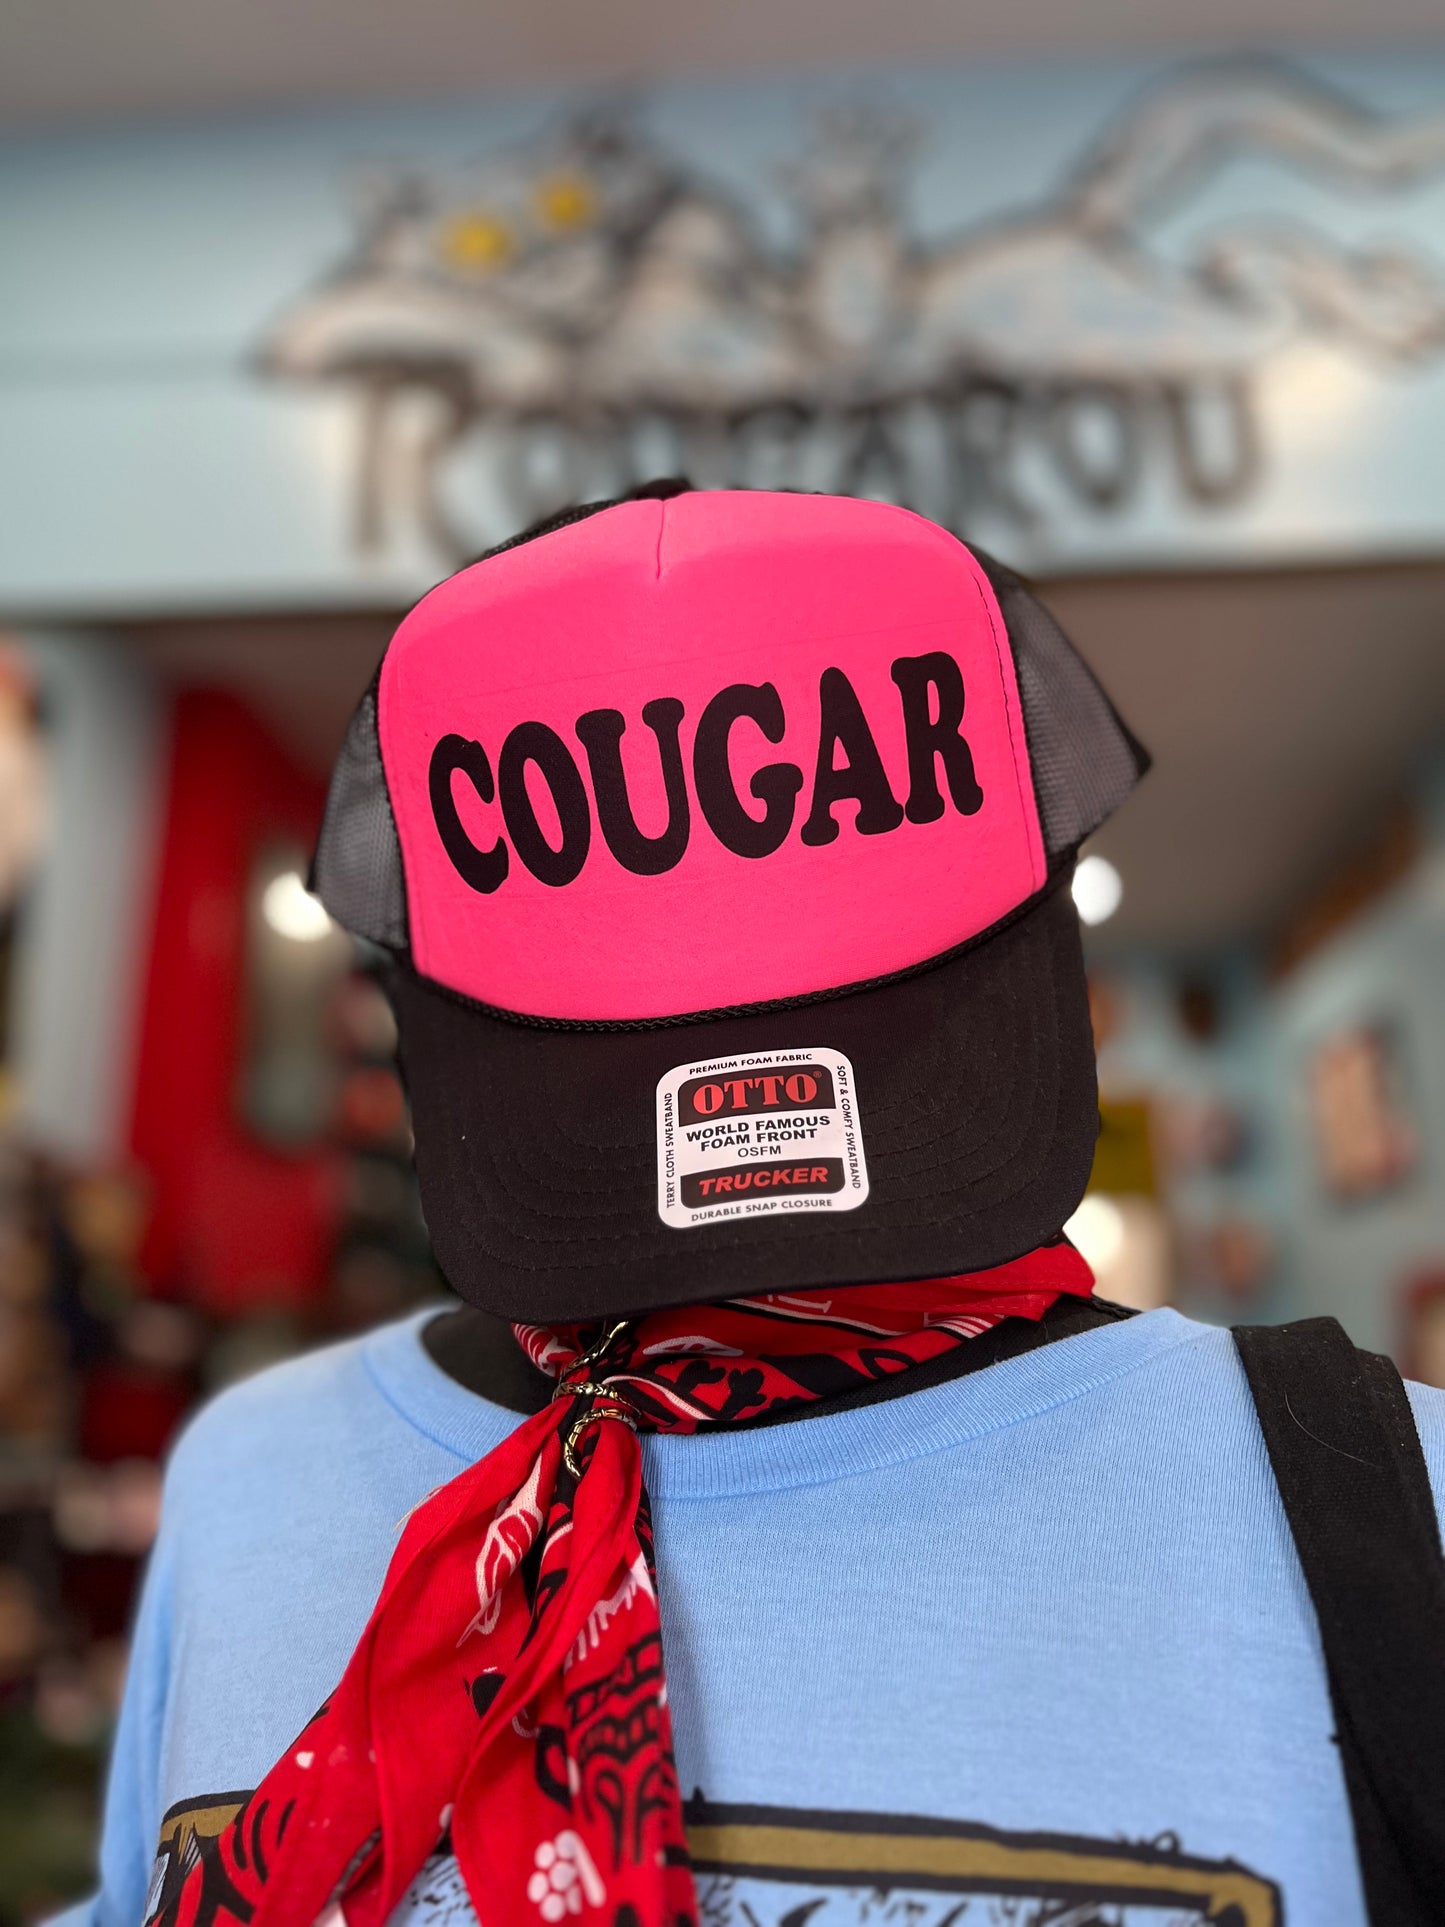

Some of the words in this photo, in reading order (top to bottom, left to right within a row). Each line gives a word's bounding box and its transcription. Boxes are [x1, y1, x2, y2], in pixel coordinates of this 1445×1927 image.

[428, 651, 984, 894] COUGAR
[689, 1061, 737, 1075] PREMIUM
[741, 1057, 772, 1066] FOAM
[776, 1054, 812, 1062] FABRIC
[837, 1066, 847, 1086] SOFT
[665, 1092, 674, 1147] SWEATBAND
[841, 1099, 853, 1129] COMFY
[686, 1122, 749, 1142] WORLD
[756, 1116, 830, 1131] FAMOUS
[701, 1134, 750, 1151] FOAM
[757, 1129, 817, 1144] FRONT
[666, 1150, 674, 1178] CLOTH
[738, 1146, 781, 1157] OSFM
[846, 1132, 861, 1189] SWEATBAND
[667, 1181, 675, 1208] TERRY
[699, 1167, 829, 1196] TRUCKER
[691, 1207, 741, 1221] DURABLE
[746, 1202, 777, 1212] SNAP
[781, 1199, 832, 1208] CLOSURE
